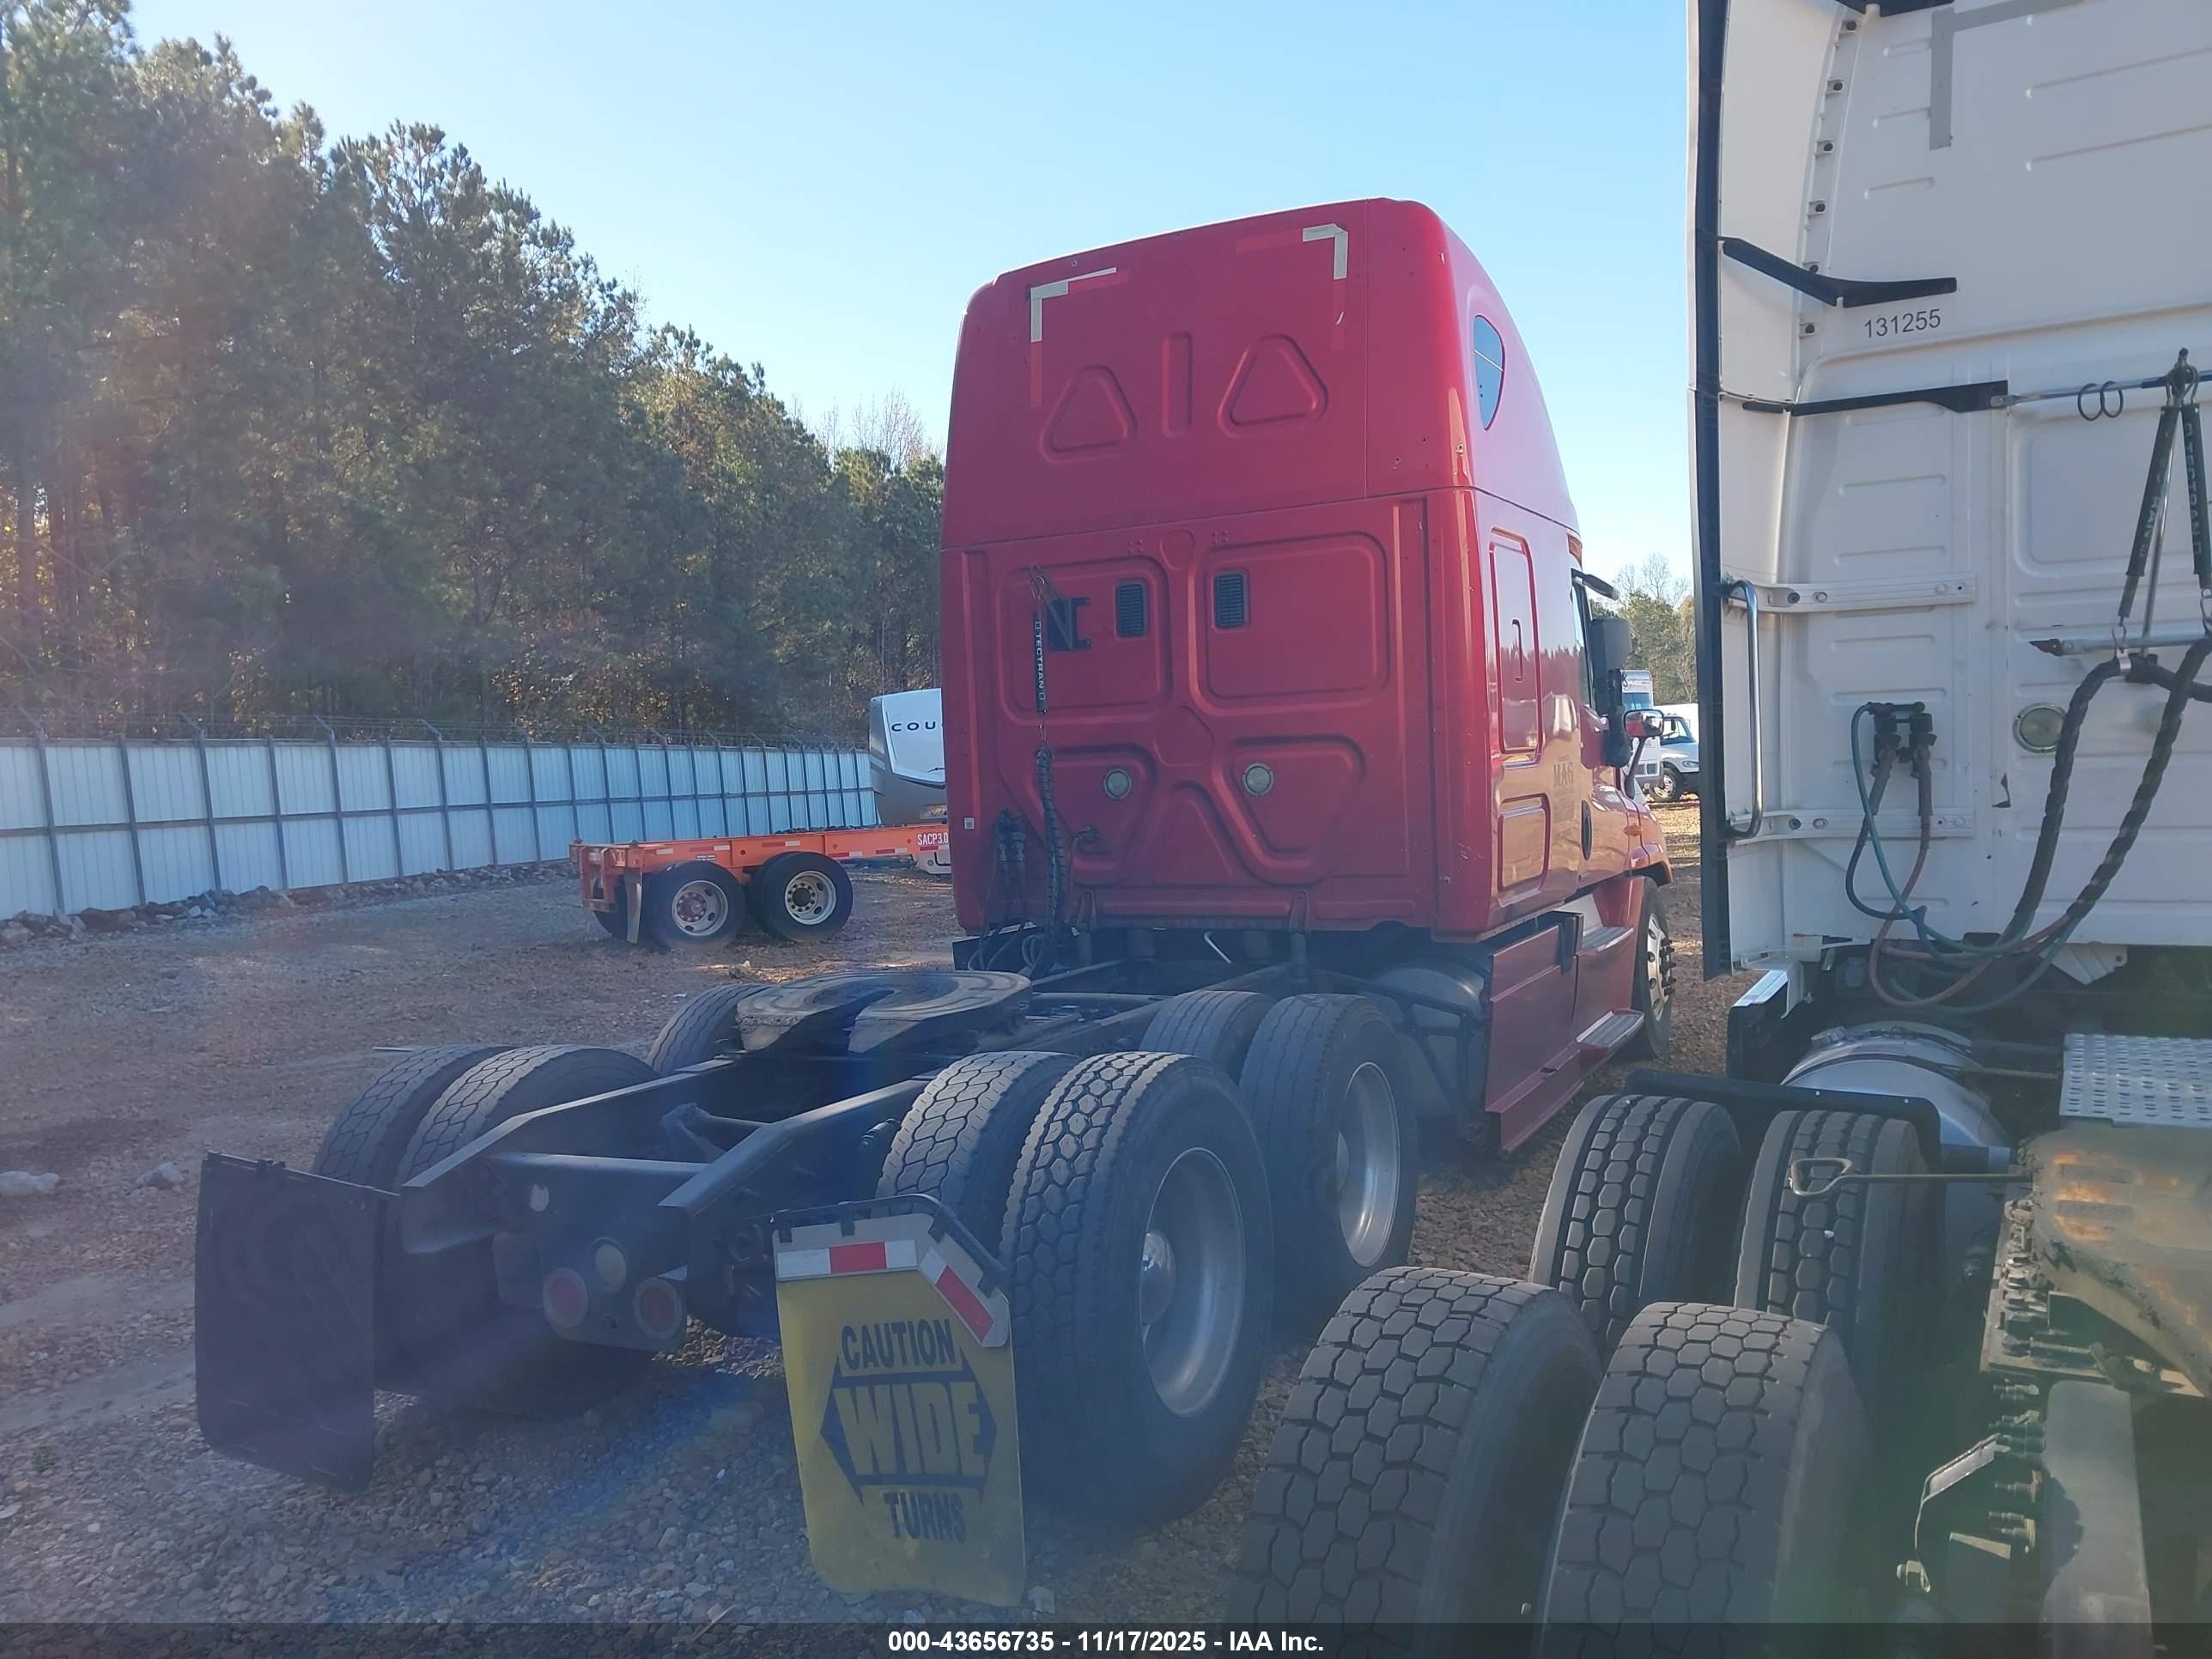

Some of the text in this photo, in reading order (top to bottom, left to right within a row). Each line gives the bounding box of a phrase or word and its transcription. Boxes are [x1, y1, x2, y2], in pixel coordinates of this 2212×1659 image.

[1863, 308, 1942, 338] 131255
[1035, 629, 1044, 689] TECTRAN
[890, 720, 937, 732] COU
[840, 1318, 957, 1370] CAUTION
[832, 1381, 987, 1479] WIDE
[882, 1491, 968, 1543] TURNS
